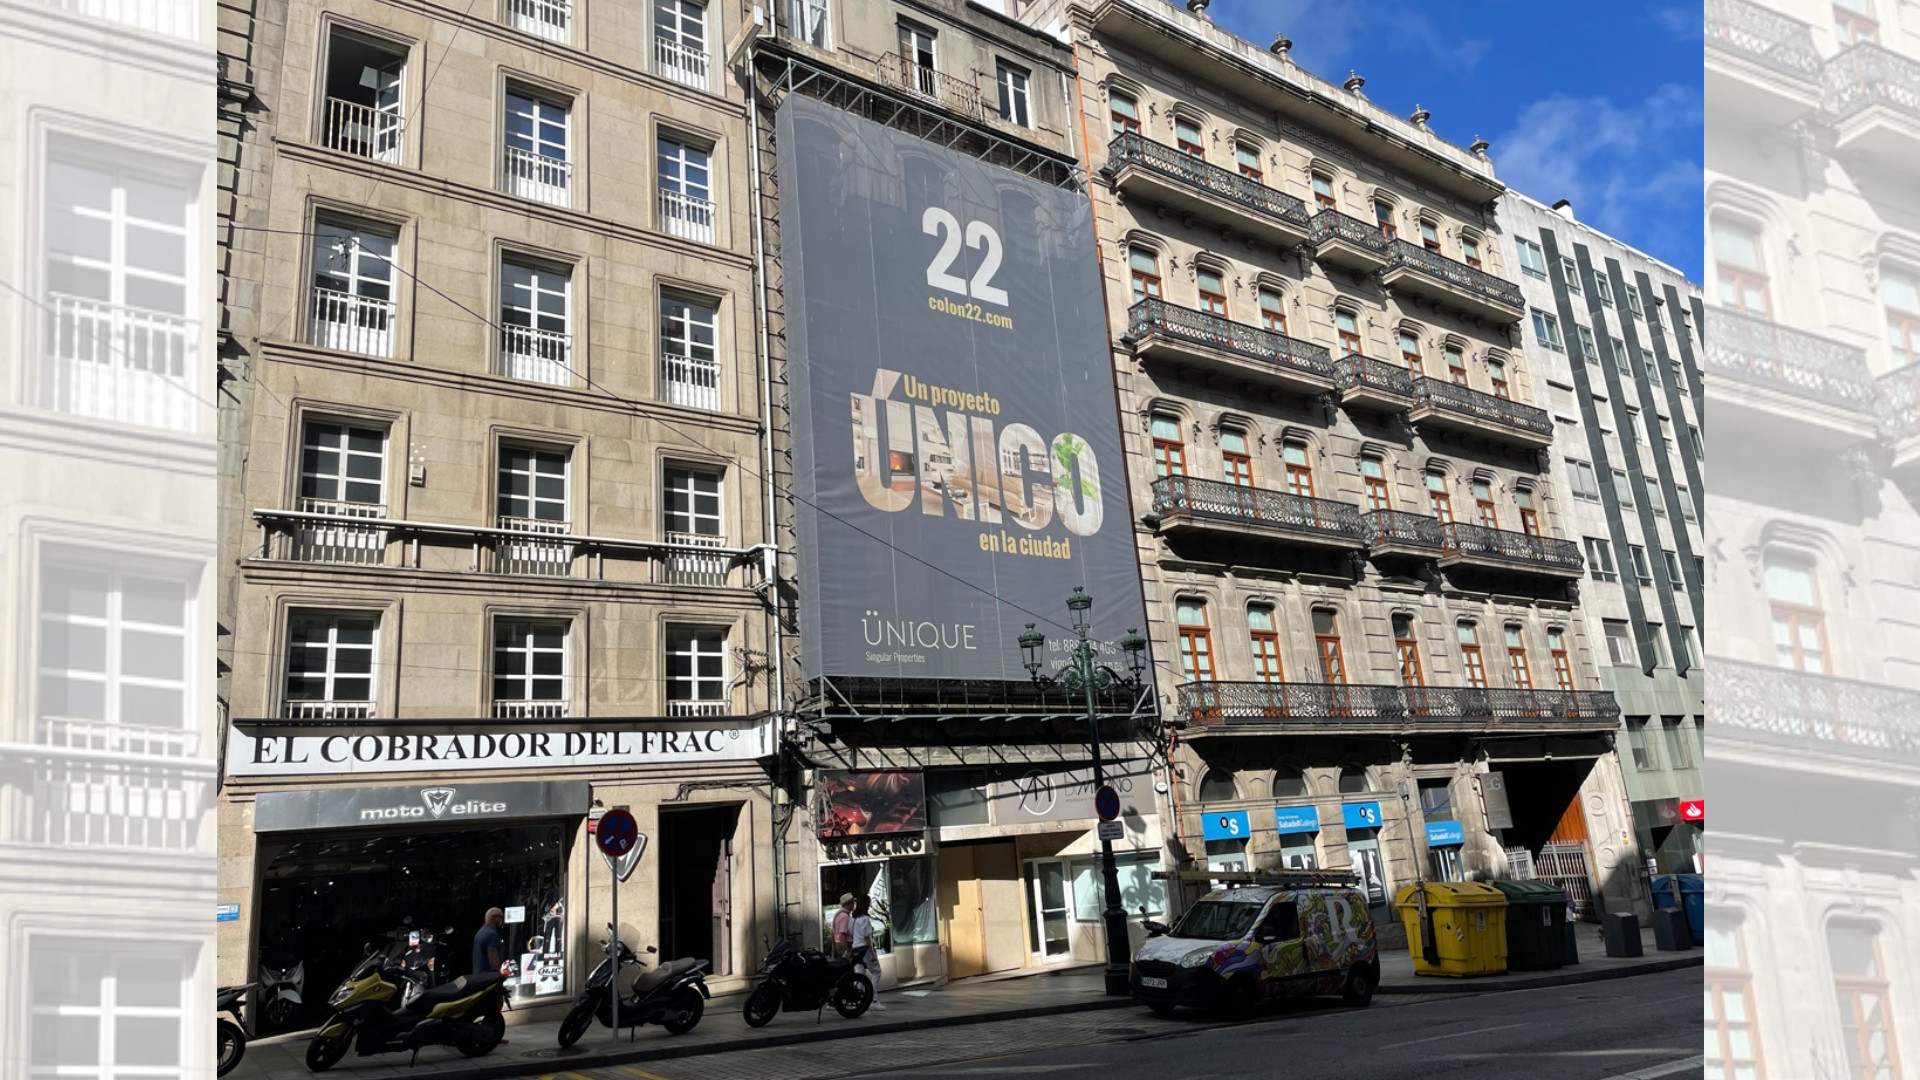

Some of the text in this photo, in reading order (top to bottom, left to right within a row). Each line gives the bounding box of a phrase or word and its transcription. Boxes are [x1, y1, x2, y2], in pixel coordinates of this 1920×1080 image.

[922, 206, 1009, 307] 22
[928, 297, 1013, 330] colon22.com
[903, 374, 1000, 416] Un proyecto
[851, 368, 1104, 536] ÚNICO
[979, 530, 1071, 560] en la ciudad
[861, 610, 977, 650] ÜNIQUE
[865, 650, 926, 664] Singular Properties
[253, 735, 309, 764] EL
[321, 732, 552, 762] COBRADOR
[563, 731, 631, 756] DEL
[640, 729, 724, 754] FRAC
[360, 799, 507, 821] moto elite
